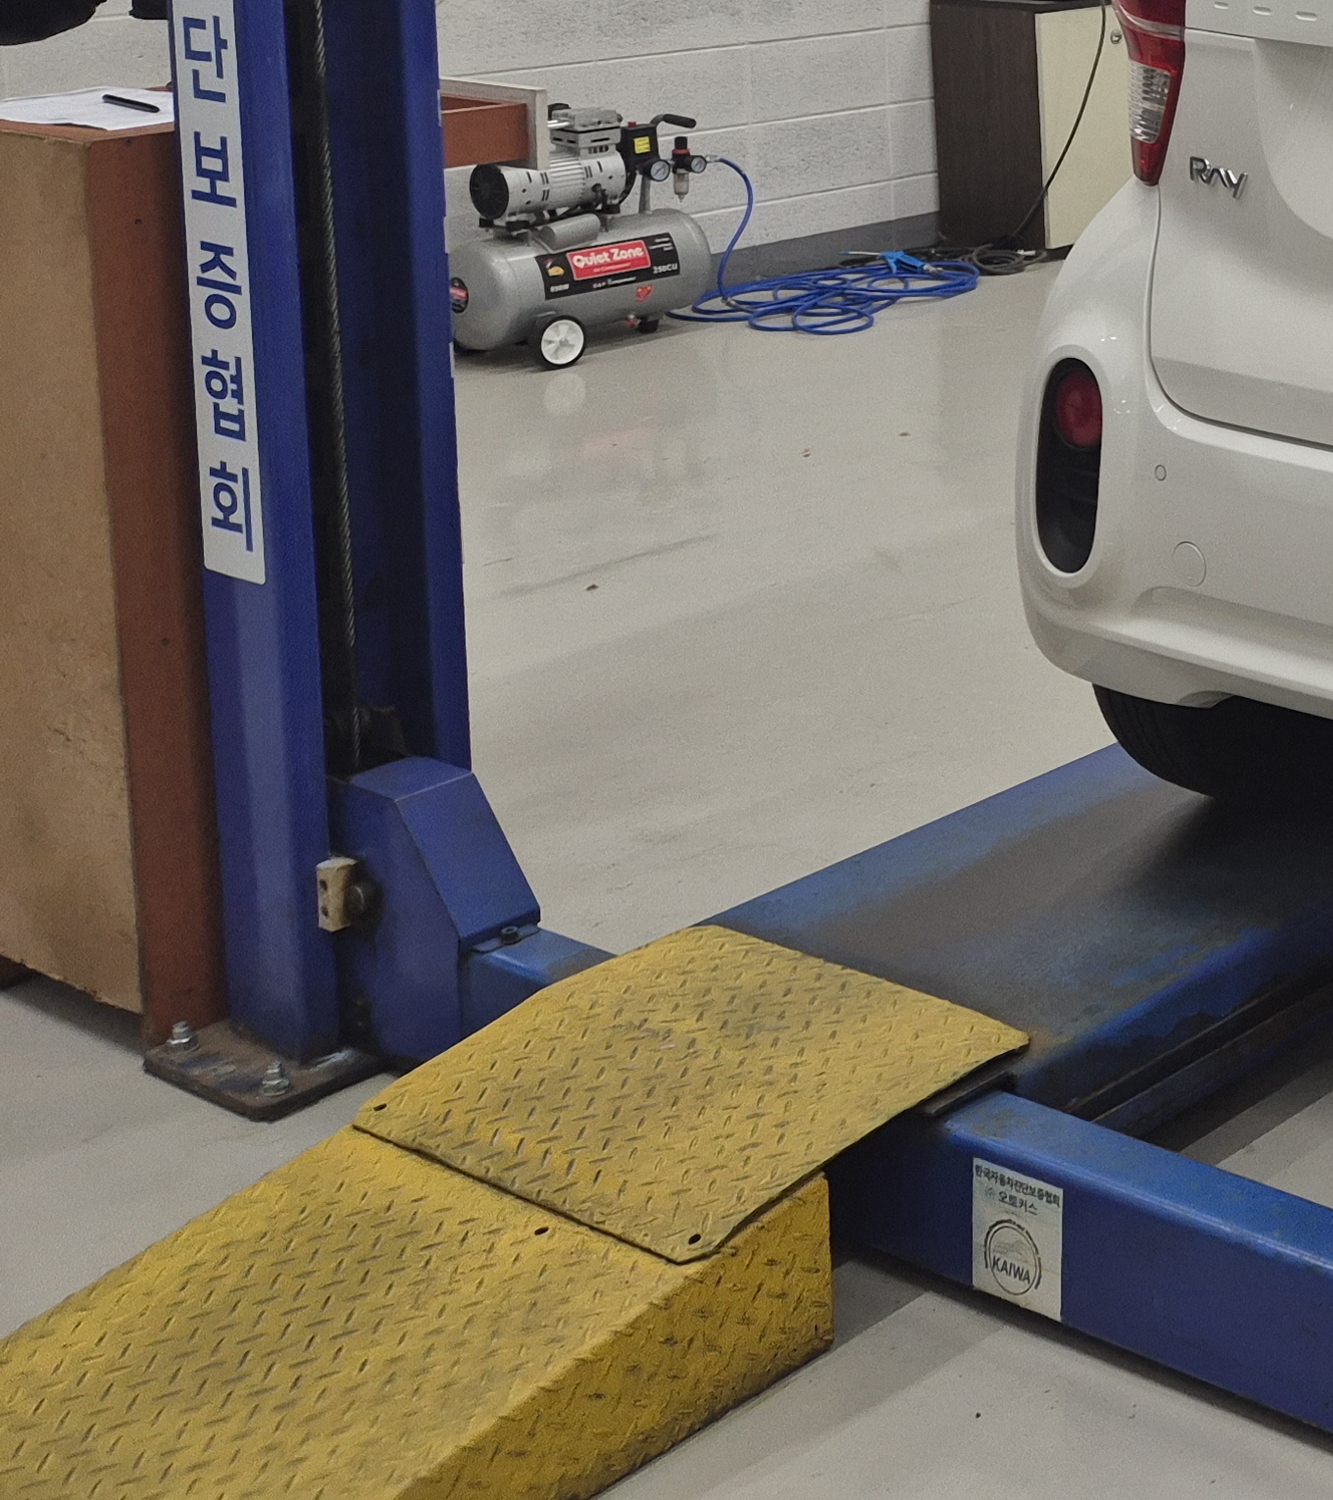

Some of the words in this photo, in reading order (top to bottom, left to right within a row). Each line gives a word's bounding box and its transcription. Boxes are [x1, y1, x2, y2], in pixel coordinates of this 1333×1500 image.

[572, 251, 611, 269] Quiet
[610, 246, 645, 261] Zone
[991, 1255, 1031, 1285] KAIWA
